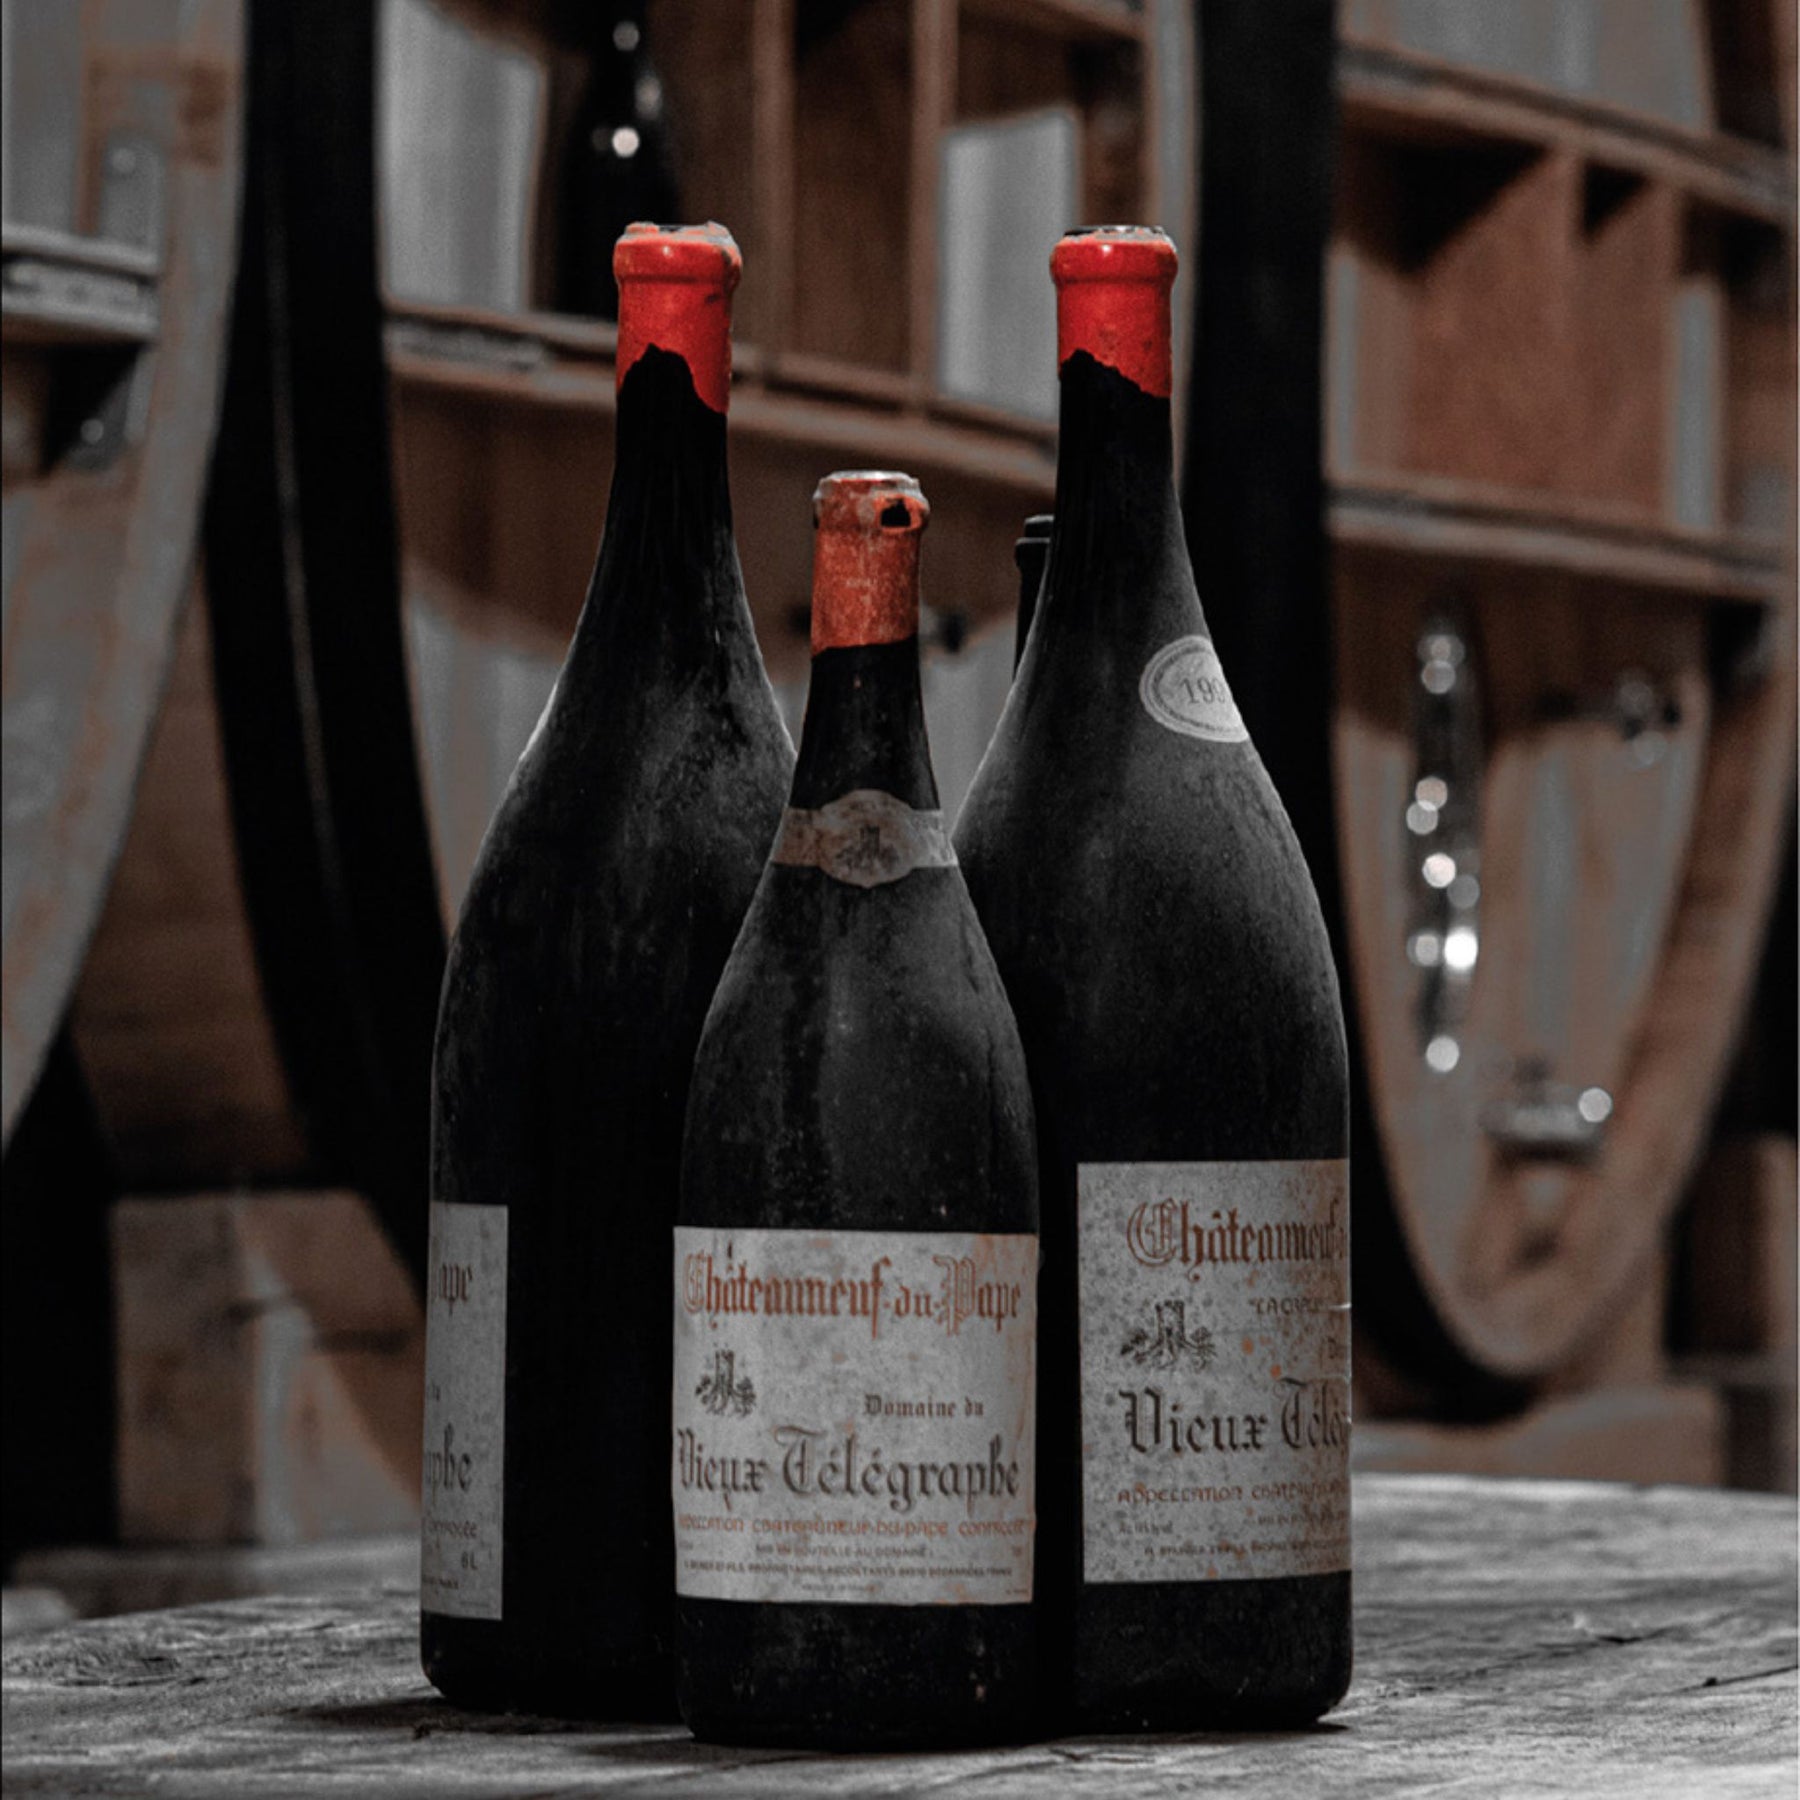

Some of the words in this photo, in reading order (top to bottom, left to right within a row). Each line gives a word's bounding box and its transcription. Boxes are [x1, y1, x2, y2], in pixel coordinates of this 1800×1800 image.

[864, 1393, 957, 1418] Domaine
[964, 1396, 984, 1417] du
[1118, 1386, 1269, 1454] Vieux
[676, 1427, 768, 1511] Vieux
[772, 1424, 1019, 1517] Télégraphe
